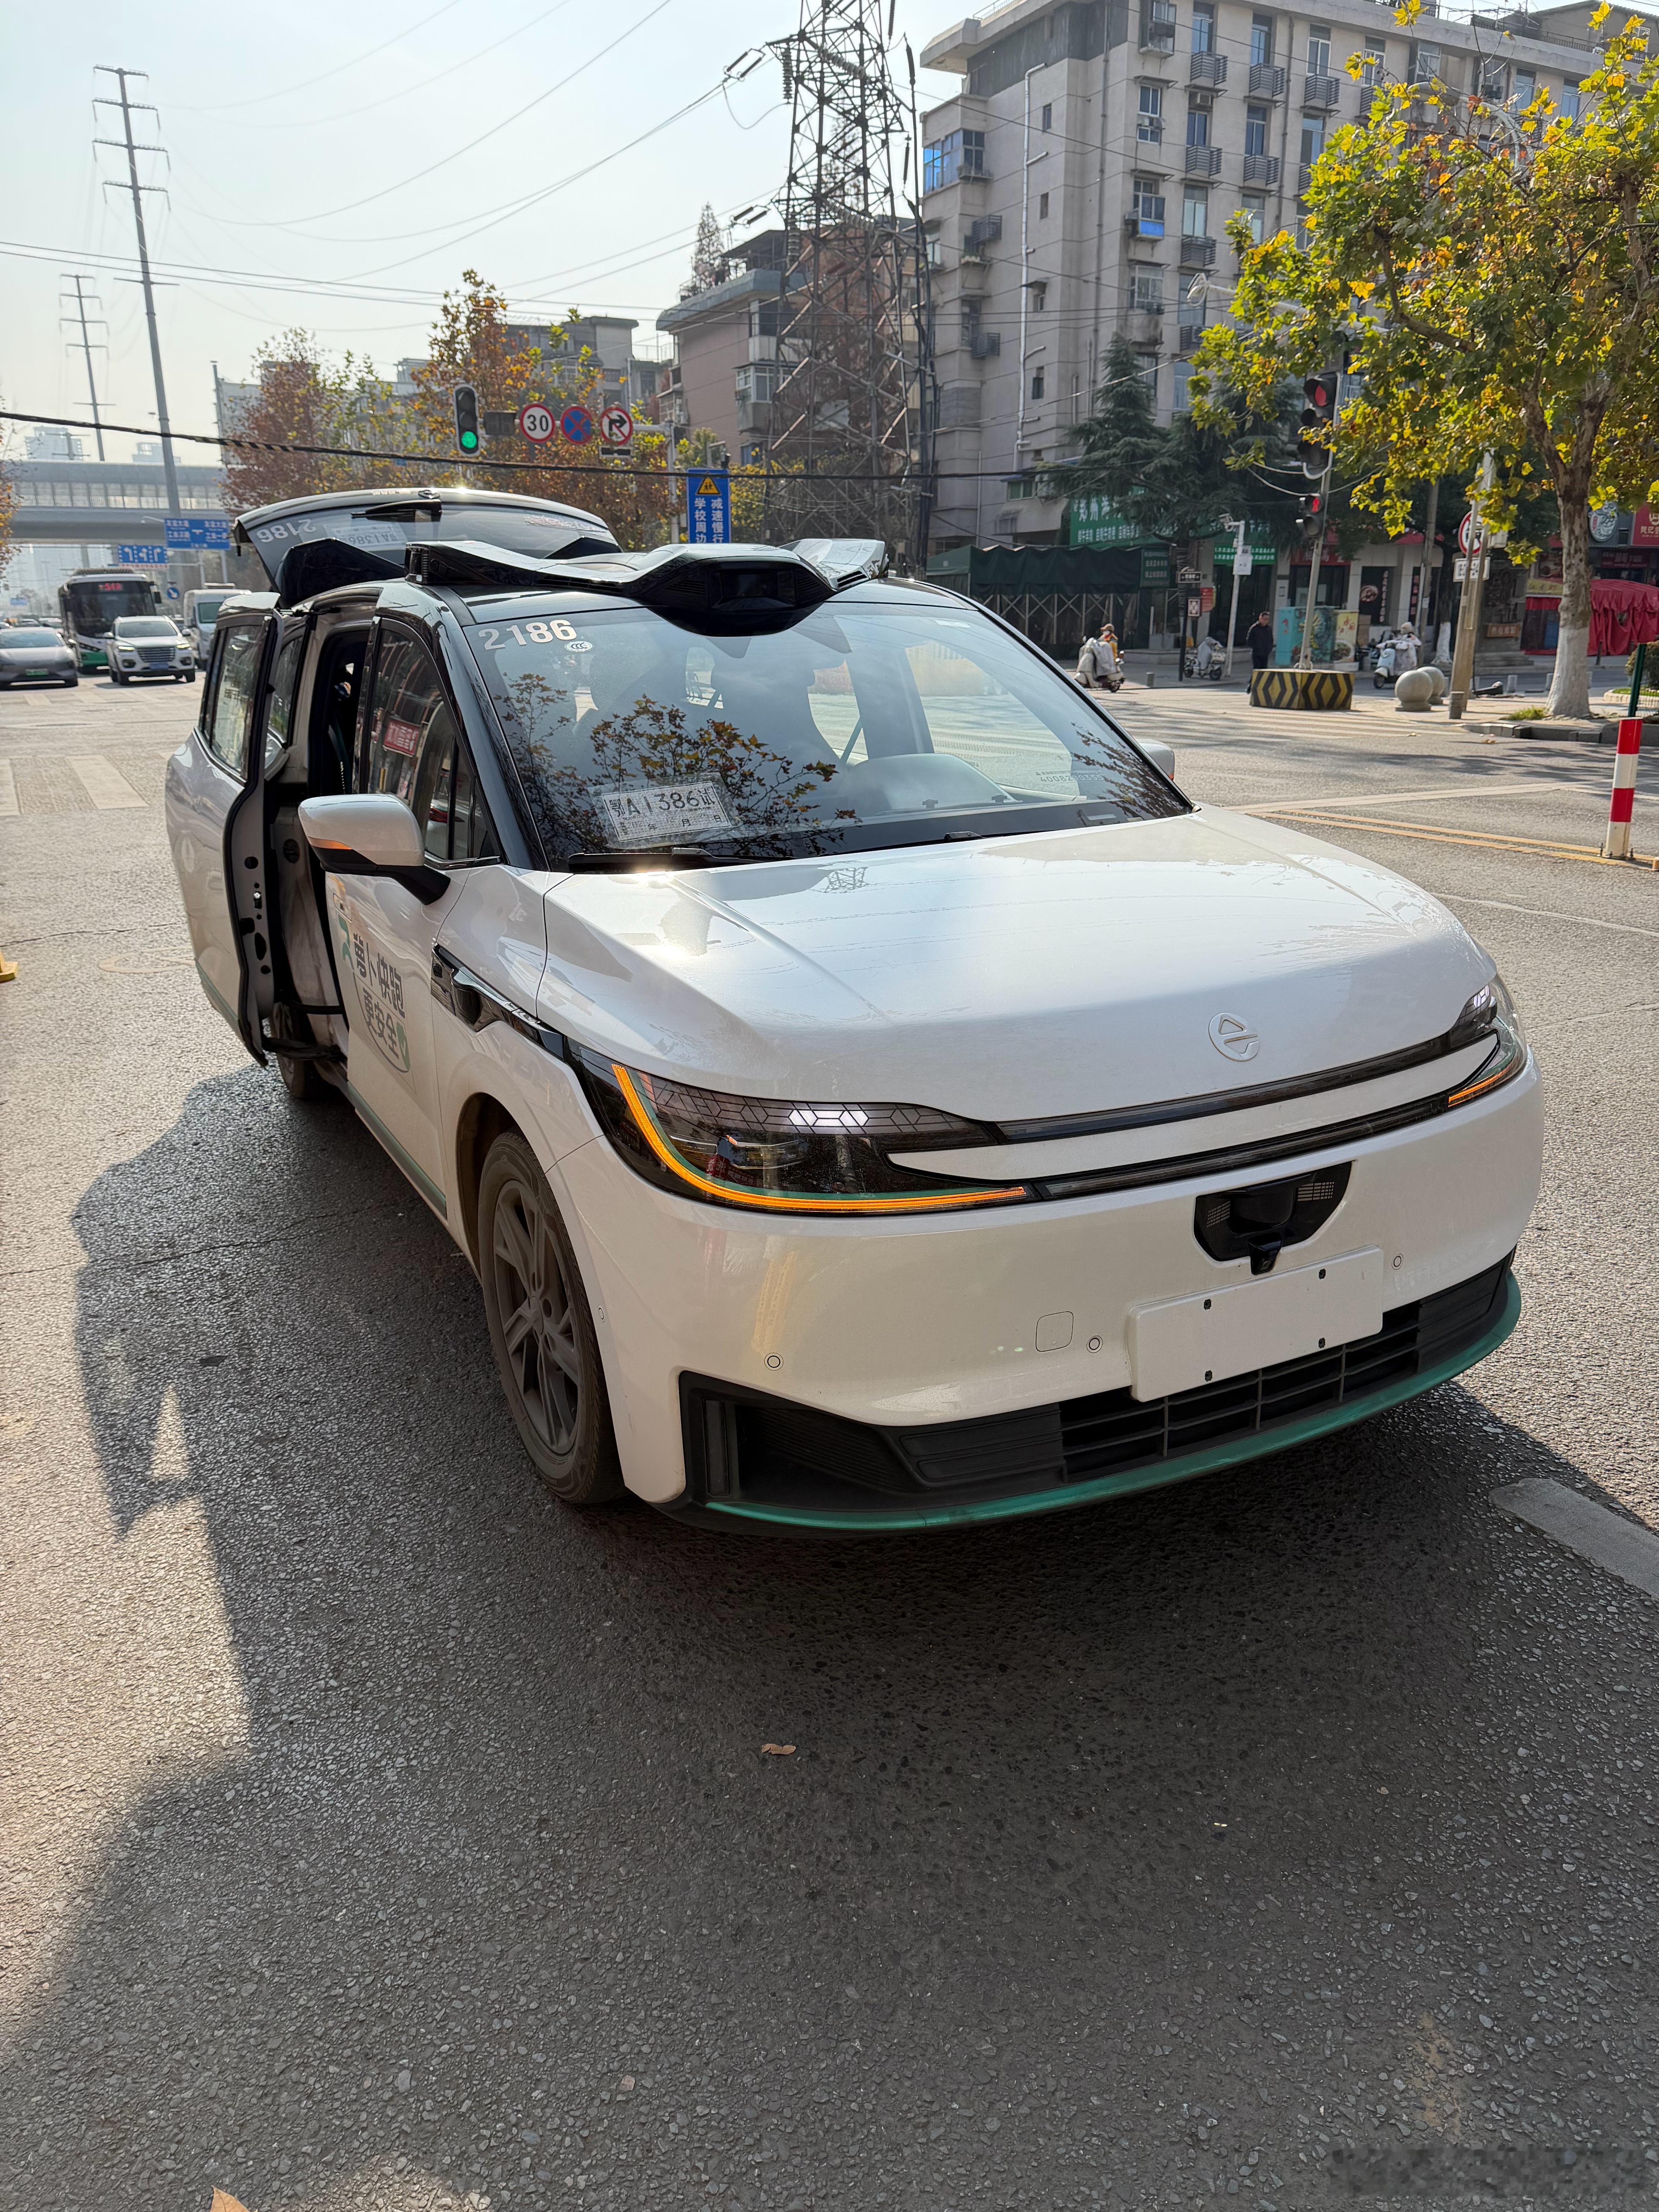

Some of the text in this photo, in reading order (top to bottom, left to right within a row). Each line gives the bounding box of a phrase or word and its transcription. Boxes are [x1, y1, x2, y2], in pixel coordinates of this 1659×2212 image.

[527, 415, 548, 432] 30
[256, 519, 316, 542] 2186
[711, 498, 724, 543] 减速慢行
[478, 620, 577, 650] 2186
[609, 788, 715, 816] 鄂A1386试
[353, 933, 405, 1018] 萝卜快跑
[363, 987, 399, 1060] 更安全
